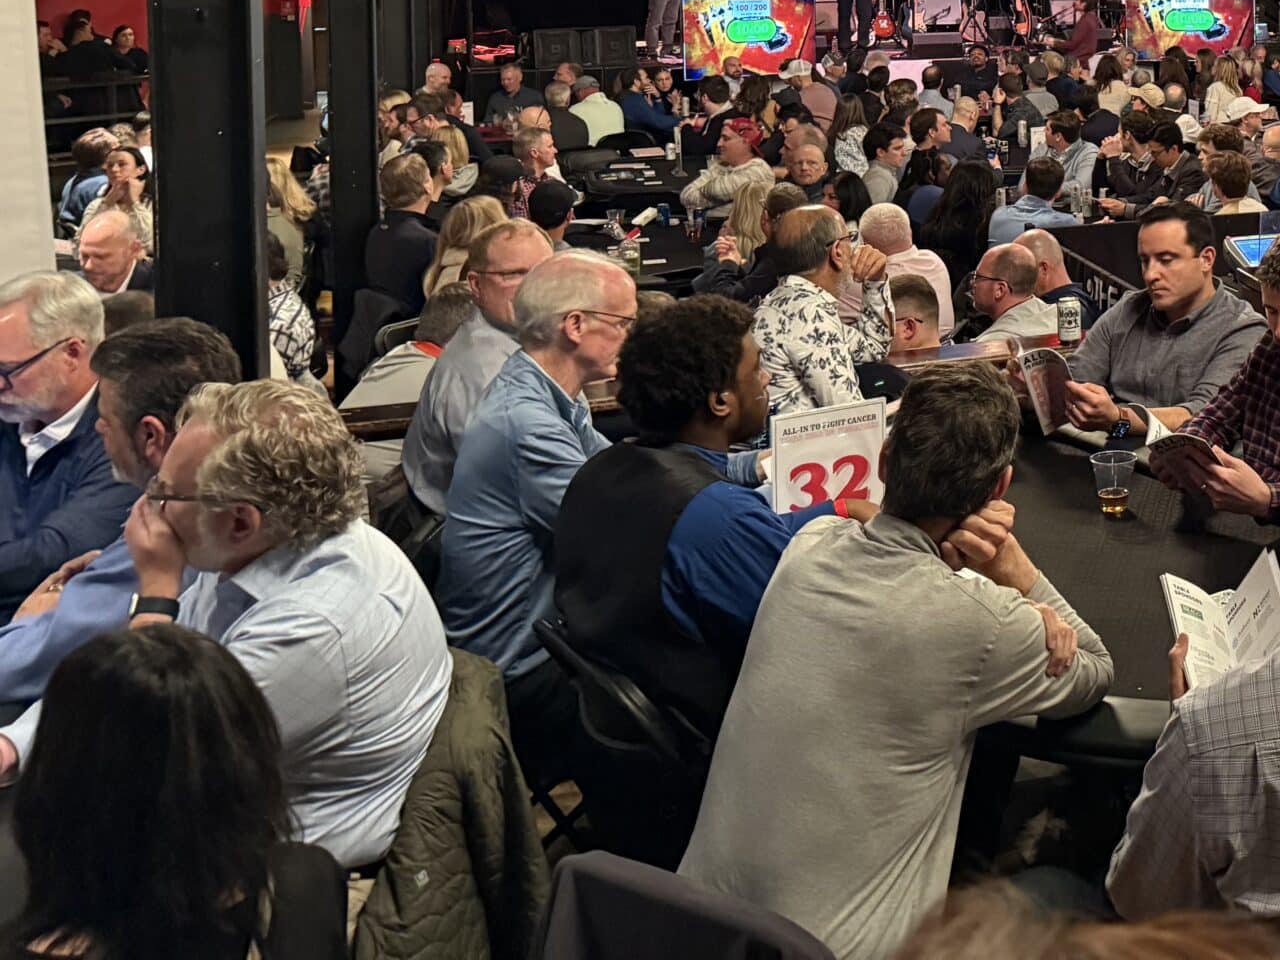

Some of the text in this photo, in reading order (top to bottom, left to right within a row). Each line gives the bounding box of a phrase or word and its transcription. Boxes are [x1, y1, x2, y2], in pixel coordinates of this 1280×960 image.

[753, 3, 768, 11] 200
[782, 423, 809, 436] ALL-IN
[810, 422, 821, 432] TO
[822, 418, 846, 429] FIGHT
[847, 413, 877, 425] CANCER
[789, 454, 871, 513] 32
